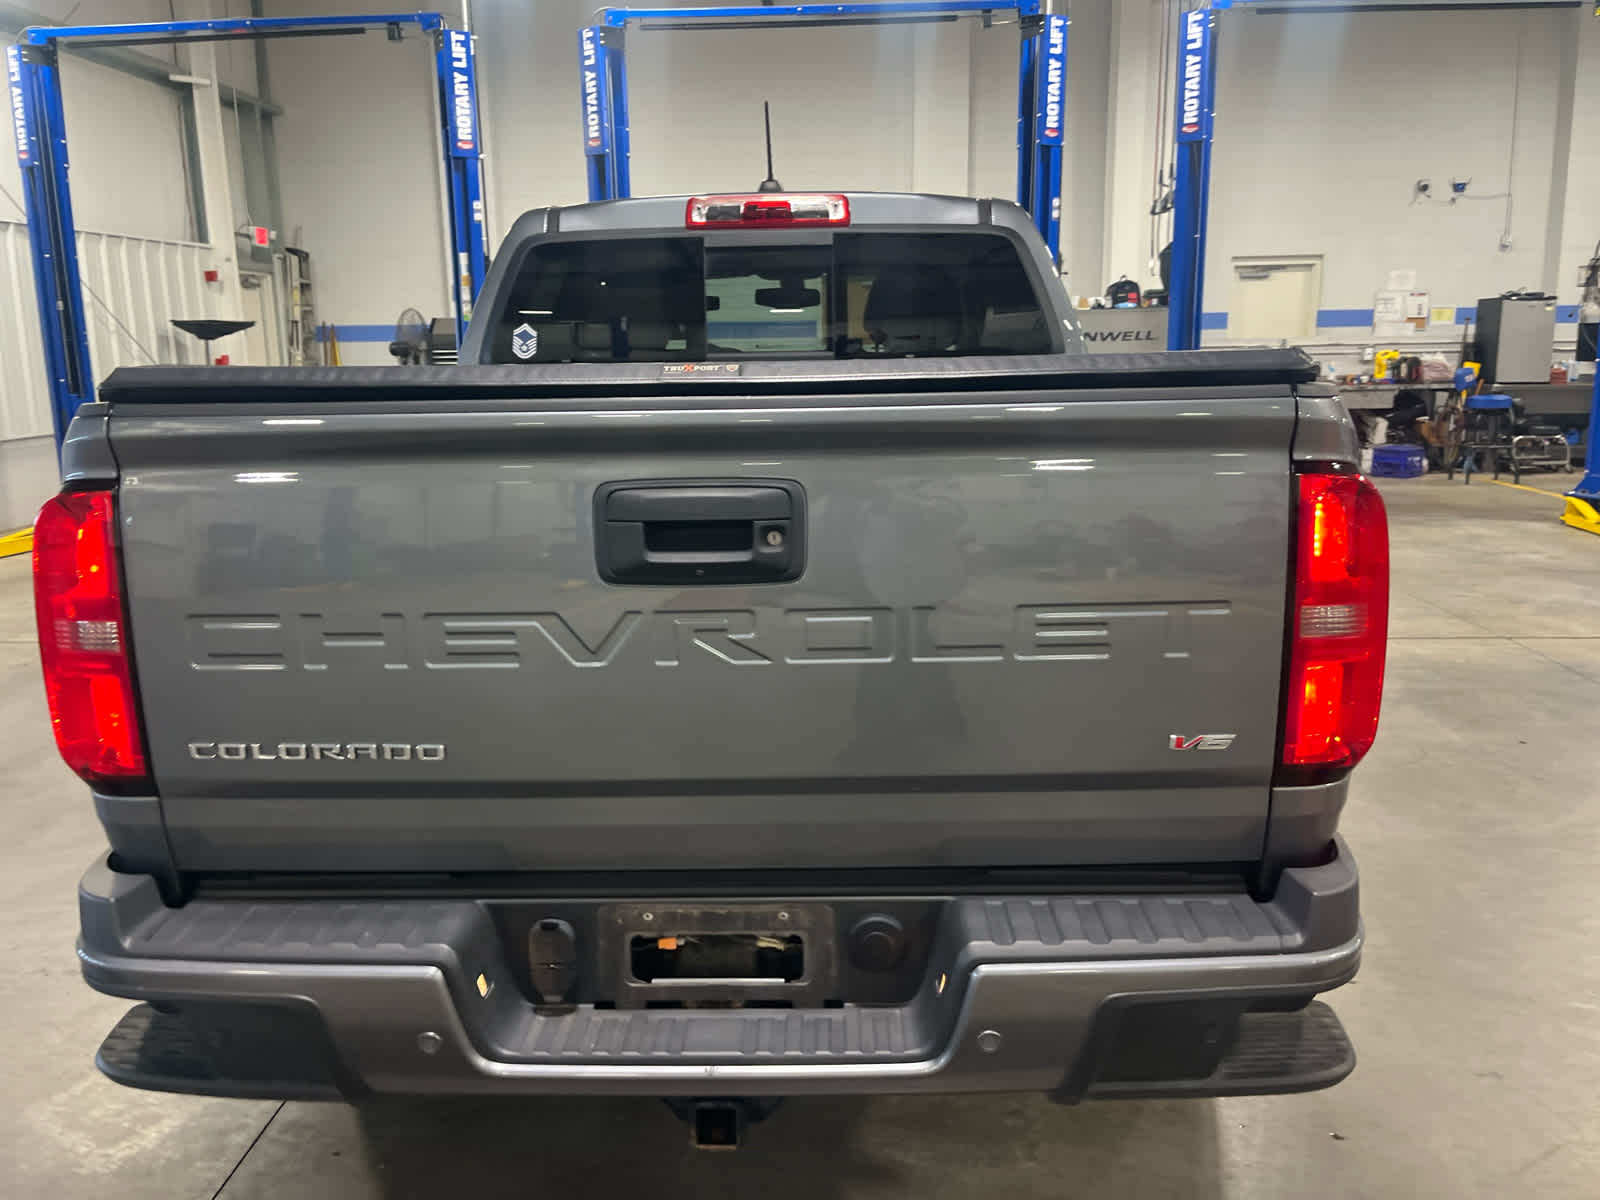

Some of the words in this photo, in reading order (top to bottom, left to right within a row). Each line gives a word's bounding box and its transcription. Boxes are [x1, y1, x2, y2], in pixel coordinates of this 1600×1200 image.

[450, 31, 467, 68] LIFT
[583, 28, 595, 65] LIFT
[1049, 16, 1064, 54] LIFT
[1186, 10, 1204, 50] LIFT
[453, 71, 473, 140] ROTARY
[585, 71, 599, 138] ROTARY
[1046, 58, 1062, 127] ROTARY
[1183, 54, 1202, 124] ROTARY
[186, 601, 1231, 669] CHEVROLET
[188, 742, 446, 762] COLORADO
[1169, 733, 1237, 750] V6
